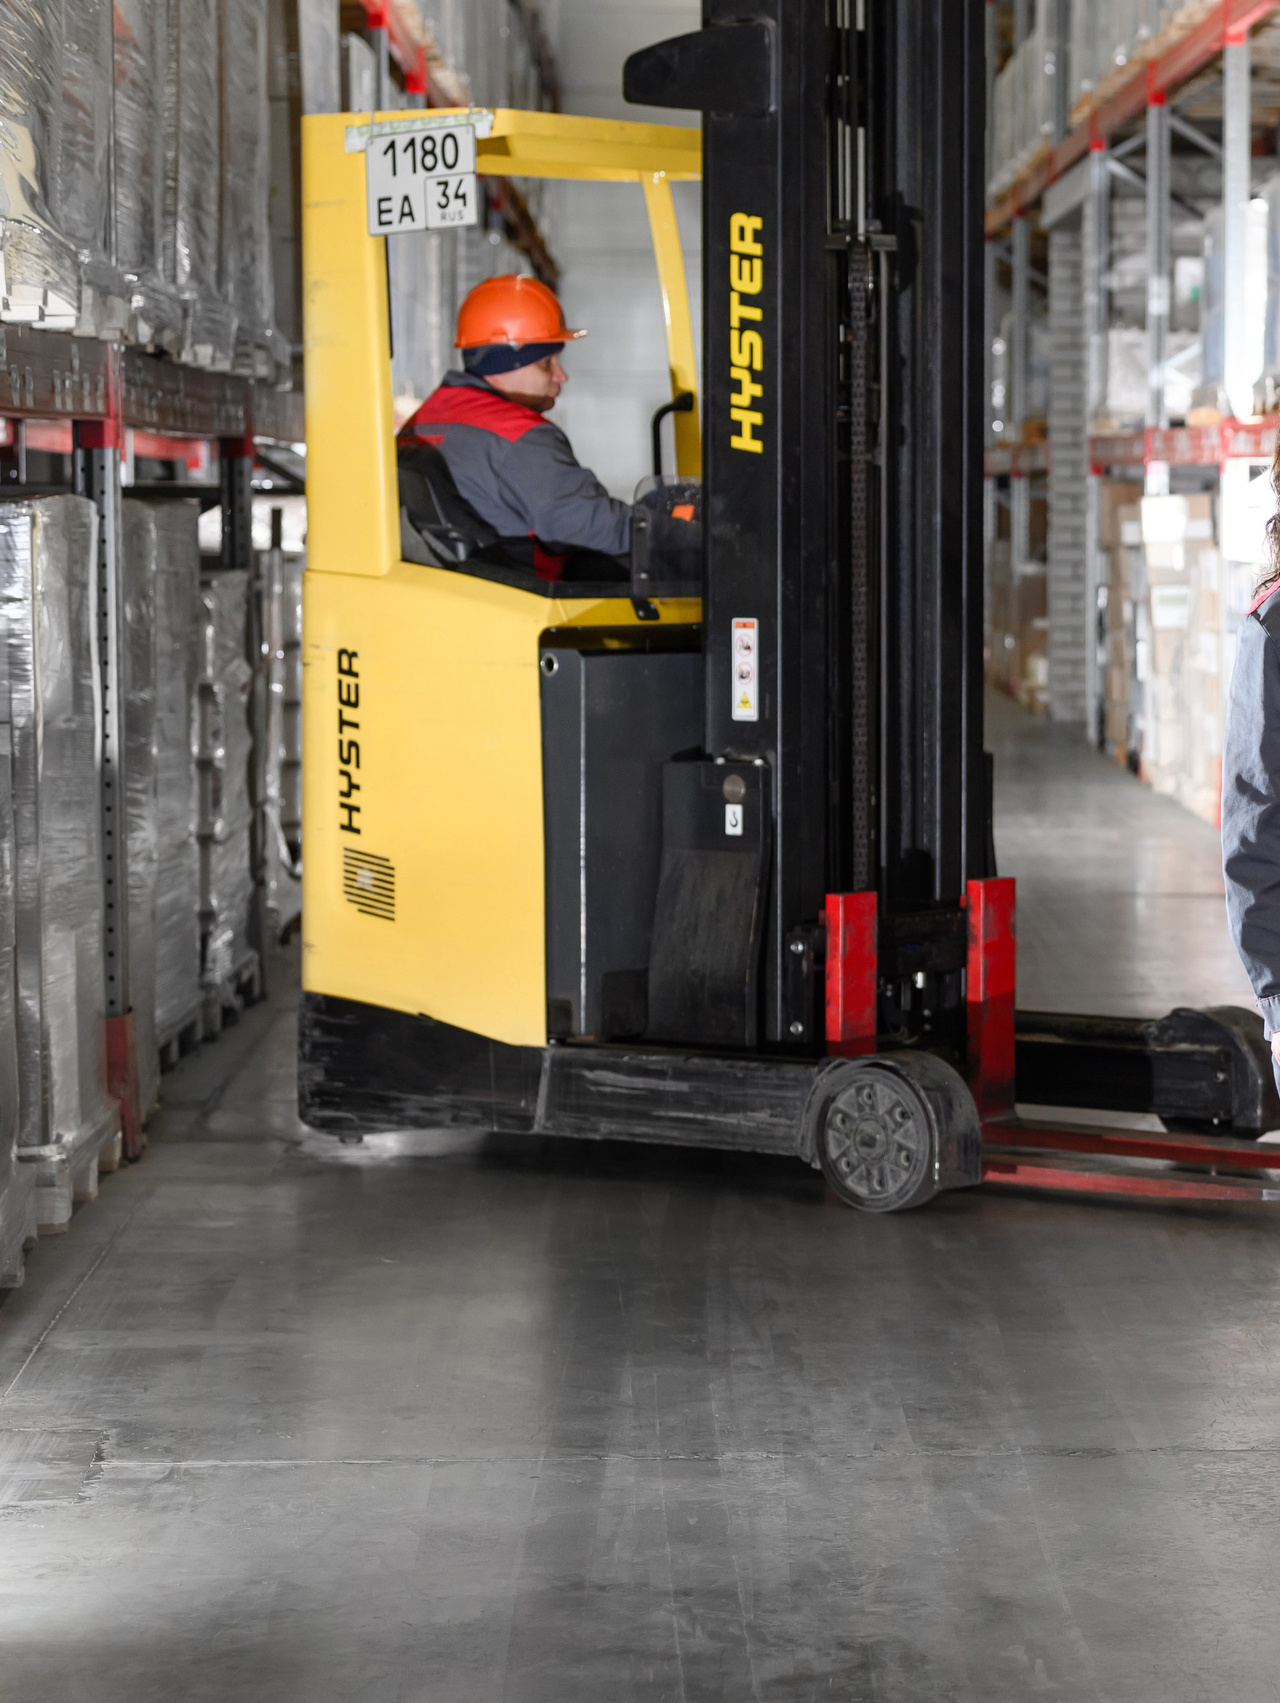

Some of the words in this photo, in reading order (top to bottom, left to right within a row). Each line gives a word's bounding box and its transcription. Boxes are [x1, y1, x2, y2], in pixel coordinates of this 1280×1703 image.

[383, 133, 459, 176] 1180
[436, 179, 467, 209] 34
[440, 210, 464, 222] RUS
[729, 212, 764, 454] HYSTER
[337, 646, 362, 836] HYSTER
